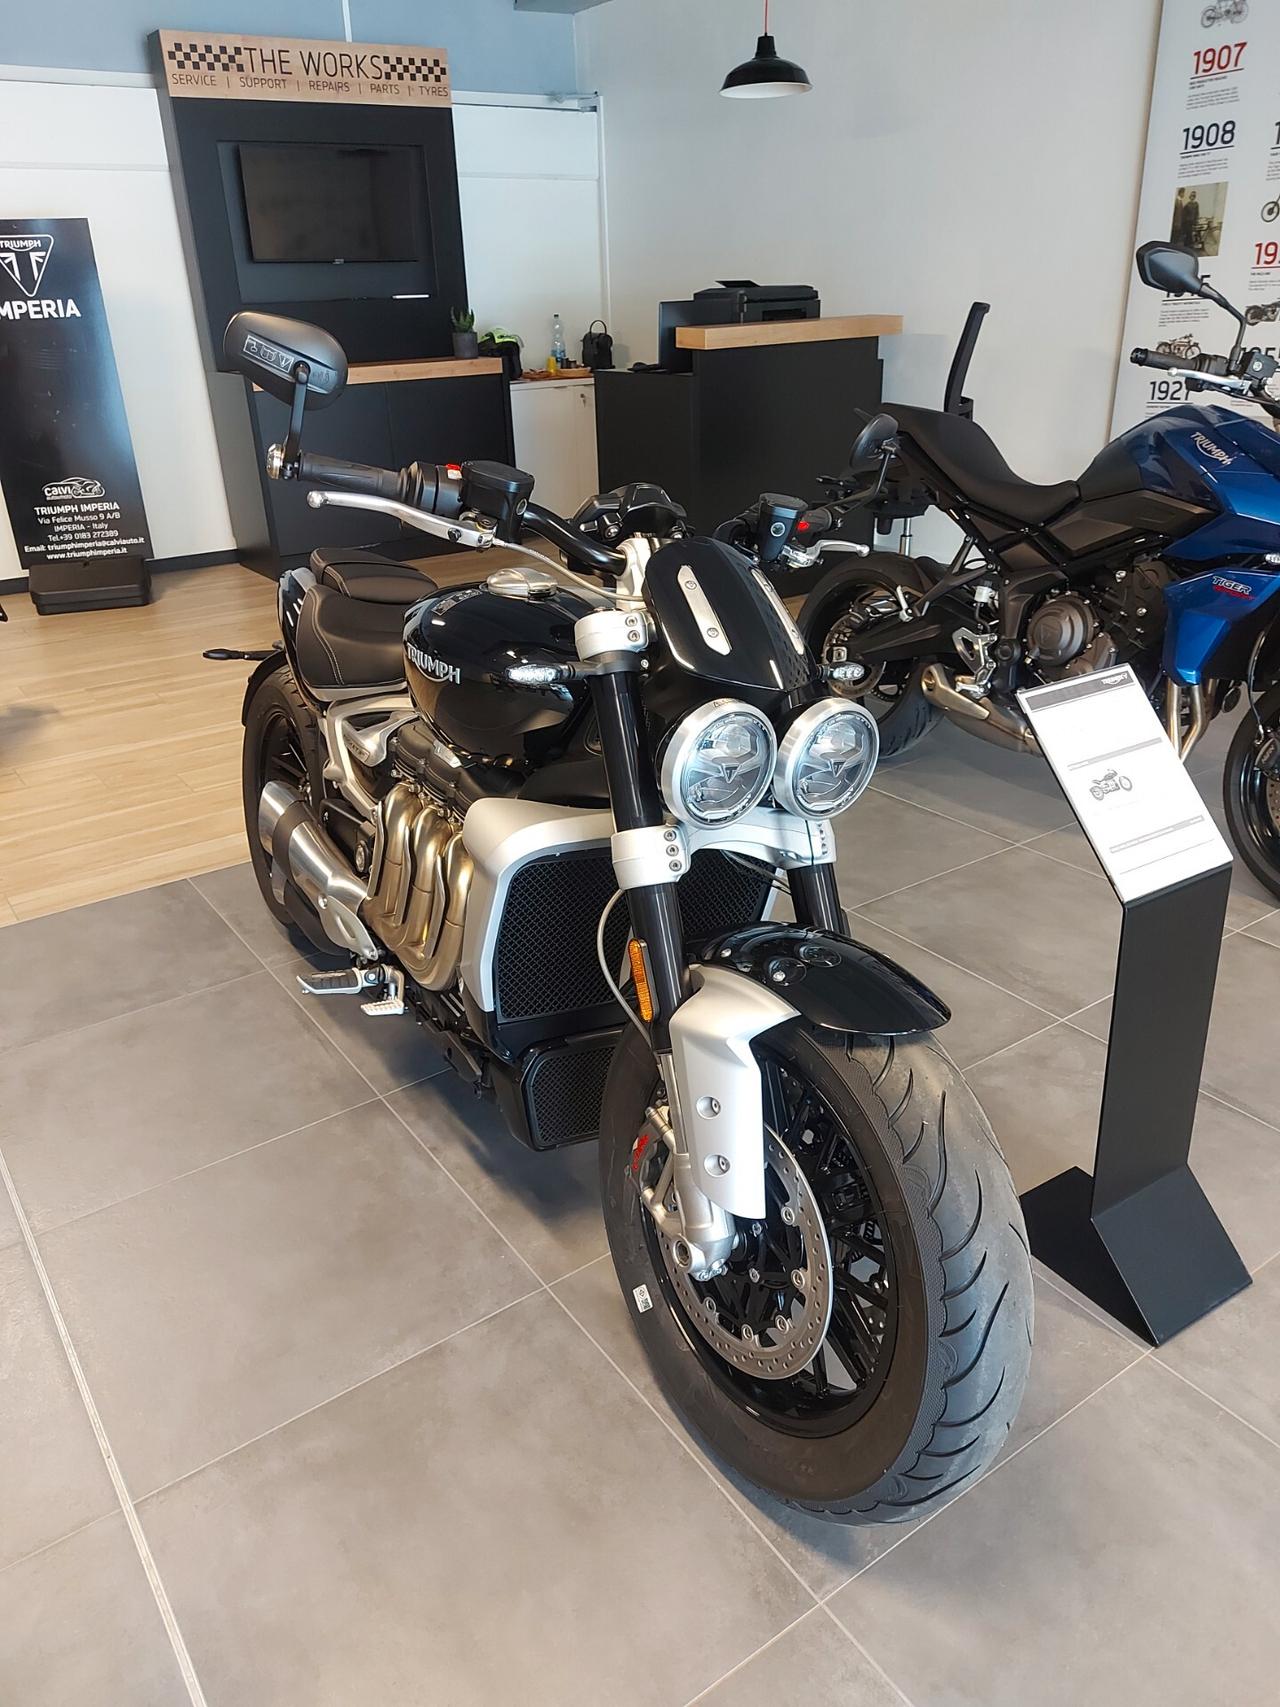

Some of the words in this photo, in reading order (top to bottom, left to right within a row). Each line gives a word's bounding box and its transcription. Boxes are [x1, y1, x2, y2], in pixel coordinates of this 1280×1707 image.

[243, 46, 293, 75] THE
[299, 50, 383, 80] WORKS
[1193, 41, 1248, 75] 1907
[172, 73, 217, 87] SERVICE
[239, 76, 288, 90] SUPPORT
[309, 80, 351, 93] REPAIRS
[370, 83, 401, 96] PARTS
[418, 86, 449, 97] TYRES
[1182, 120, 1236, 150] 1908
[0, 239, 42, 250] TRIUMPH
[1255, 241, 1280, 265] 19
[0, 299, 82, 320] MPERIA
[1190, 431, 1232, 465] TRIUMPH
[34, 504, 79, 516] TRIUMPH
[80, 501, 120, 513] IMPERIA
[38, 516, 51, 525] Via
[52, 515, 73, 524] Felice
[74, 513, 98, 522] Musso
[99, 512, 105, 520] 9
[53, 524, 86, 533] IMPERIA
[92, 522, 108, 531] Italy
[46, 546, 128, 560] www.triumphimperia.it
[1212, 575, 1252, 595] TIGER
[406, 641, 461, 685] TRIUMPH
